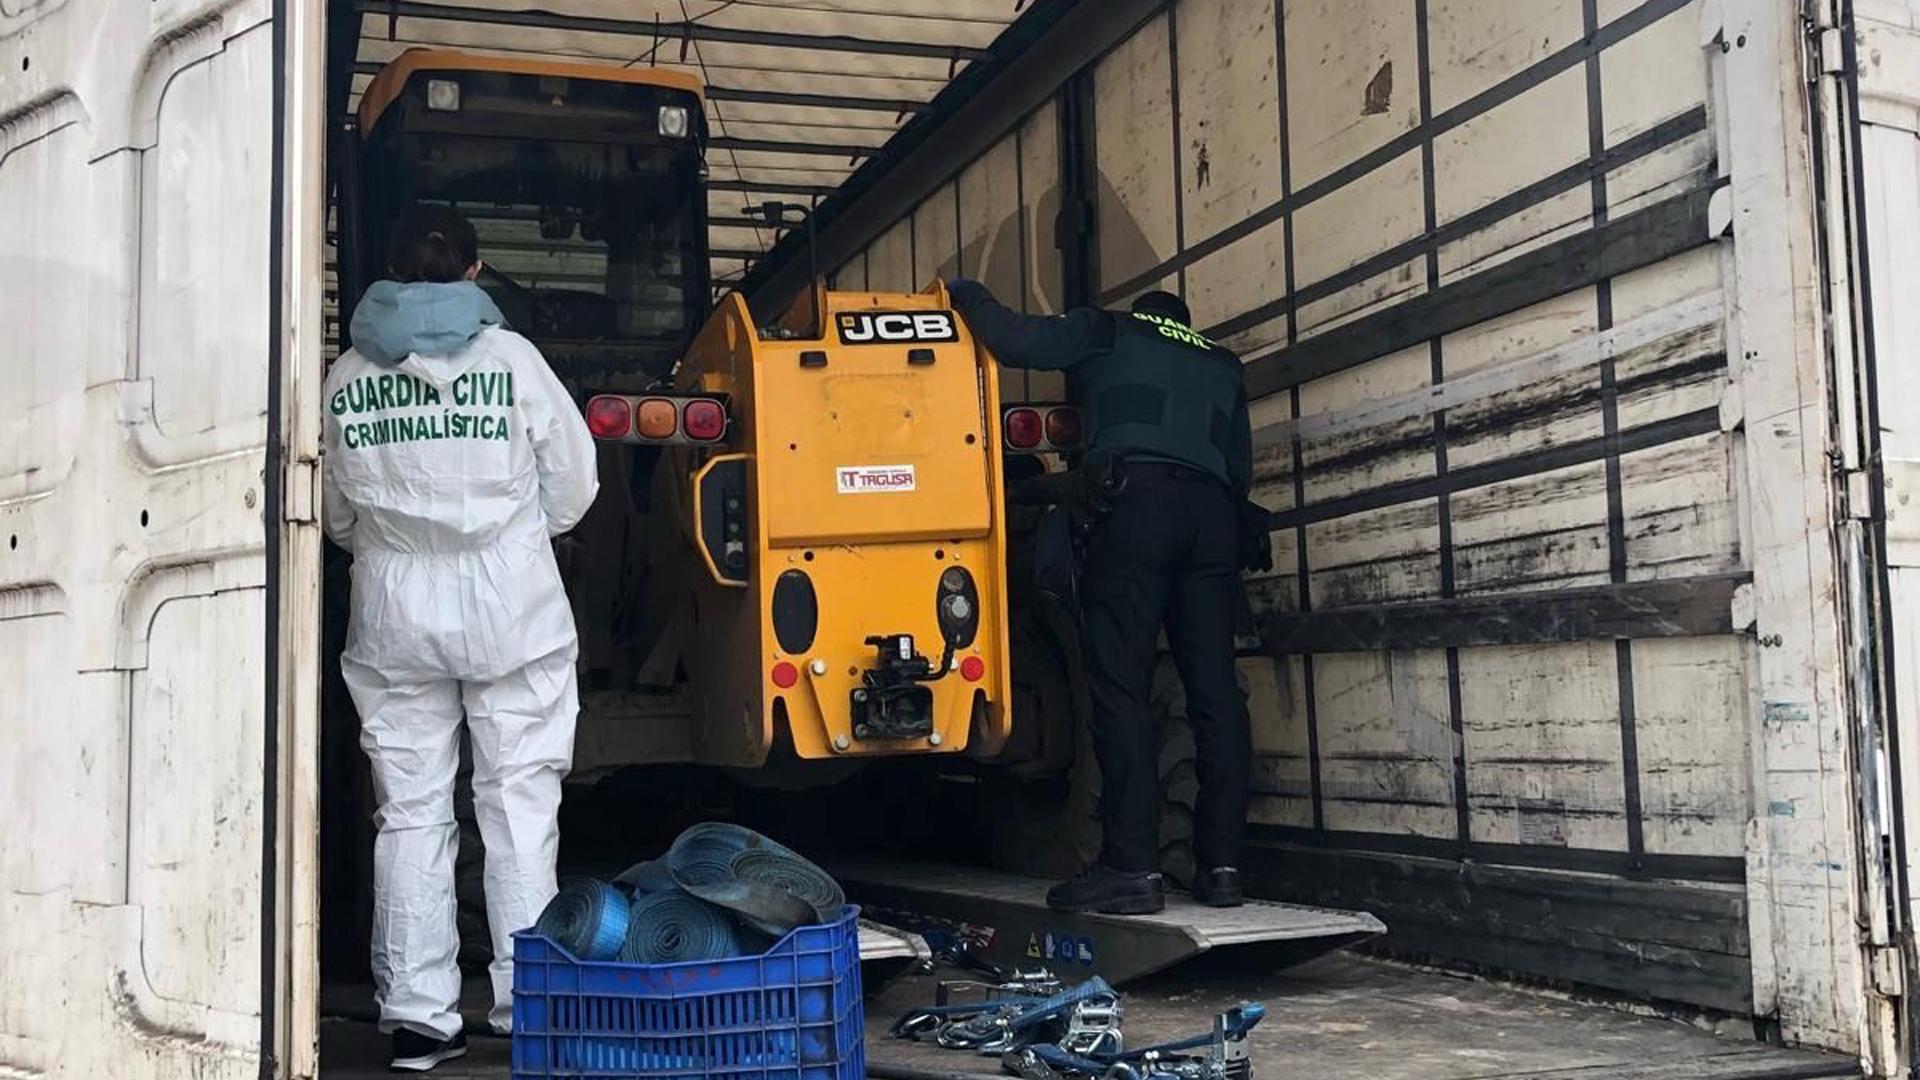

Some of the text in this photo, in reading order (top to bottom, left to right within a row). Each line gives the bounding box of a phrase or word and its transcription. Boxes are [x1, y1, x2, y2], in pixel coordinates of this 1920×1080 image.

[842, 315, 953, 341] JCB
[1158, 326, 1211, 350] CIVIL
[330, 372, 514, 416] GUARDIA CIVIL
[344, 409, 510, 450] CRIMINALÍSTICA
